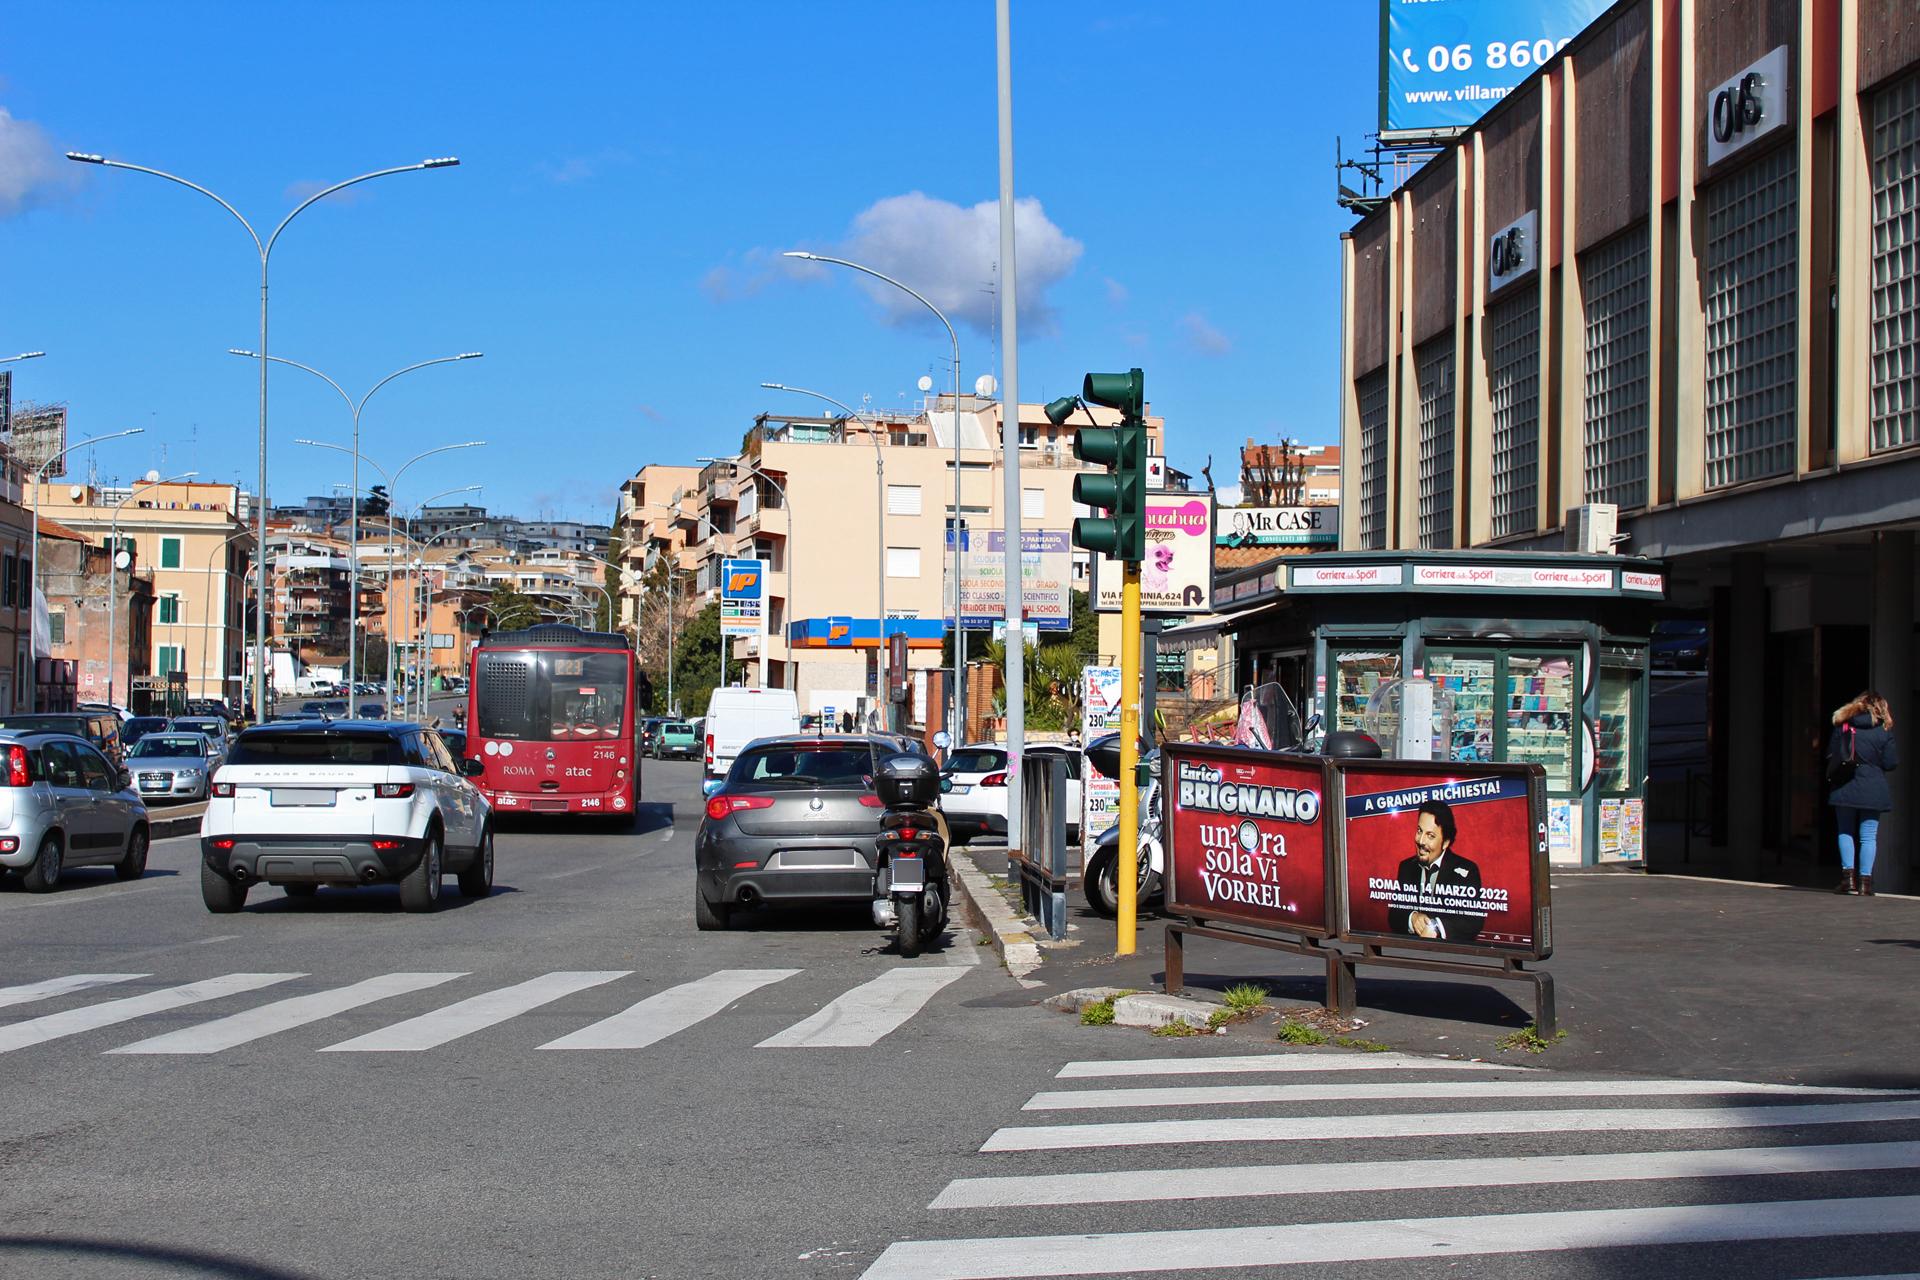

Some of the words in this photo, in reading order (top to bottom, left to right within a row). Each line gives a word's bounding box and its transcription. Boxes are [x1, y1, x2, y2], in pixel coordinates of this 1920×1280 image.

[1428, 44, 1472, 72] 06
[1487, 38, 1572, 69] 860
[1405, 89, 1452, 103] www.
[1455, 83, 1517, 101] villama
[1712, 72, 1764, 143] OVS
[1492, 227, 1523, 277] OVS
[1276, 511, 1322, 530] CASE
[1316, 570, 1345, 580] Corriere
[1356, 569, 1377, 581] Sport
[1421, 568, 1455, 579] Corriere
[1469, 569, 1493, 582] Sport
[1534, 571, 1568, 582] Corriere
[1582, 572, 1606, 584] Sport
[1625, 574, 1643, 585] Corriere
[728, 573, 758, 592] IP
[1024, 592, 1059, 601] SCIENTIFICO
[1101, 591, 1117, 600] VIA
[1089, 714, 1103, 728] 230
[593, 751, 615, 760] 2146
[503, 766, 536, 776] ROMA
[565, 767, 592, 777] atac
[1181, 763, 1220, 782] Enrico
[497, 797, 517, 806] atac
[581, 799, 600, 807] 2146
[1180, 781, 1318, 821] BRIGNANO
[1365, 799, 1374, 811] A
[1377, 791, 1428, 809] GRANDE
[1432, 781, 1501, 802] RICHIESTA!
[1089, 798, 1105, 812] 230
[1206, 843, 1254, 876] sola
[1256, 857, 1279, 882] Vi
[1368, 878, 1401, 890] ROMA
[1403, 883, 1418, 893] DAL
[1420, 883, 1433, 894] 14
[1435, 884, 1476, 898] MARZO
[1479, 887, 1508, 901] 2022
[1369, 890, 1418, 904] AUDITORIUM
[1419, 895, 1443, 906] DELLA
[1444, 897, 1509, 912] CONCILIAZIONE
